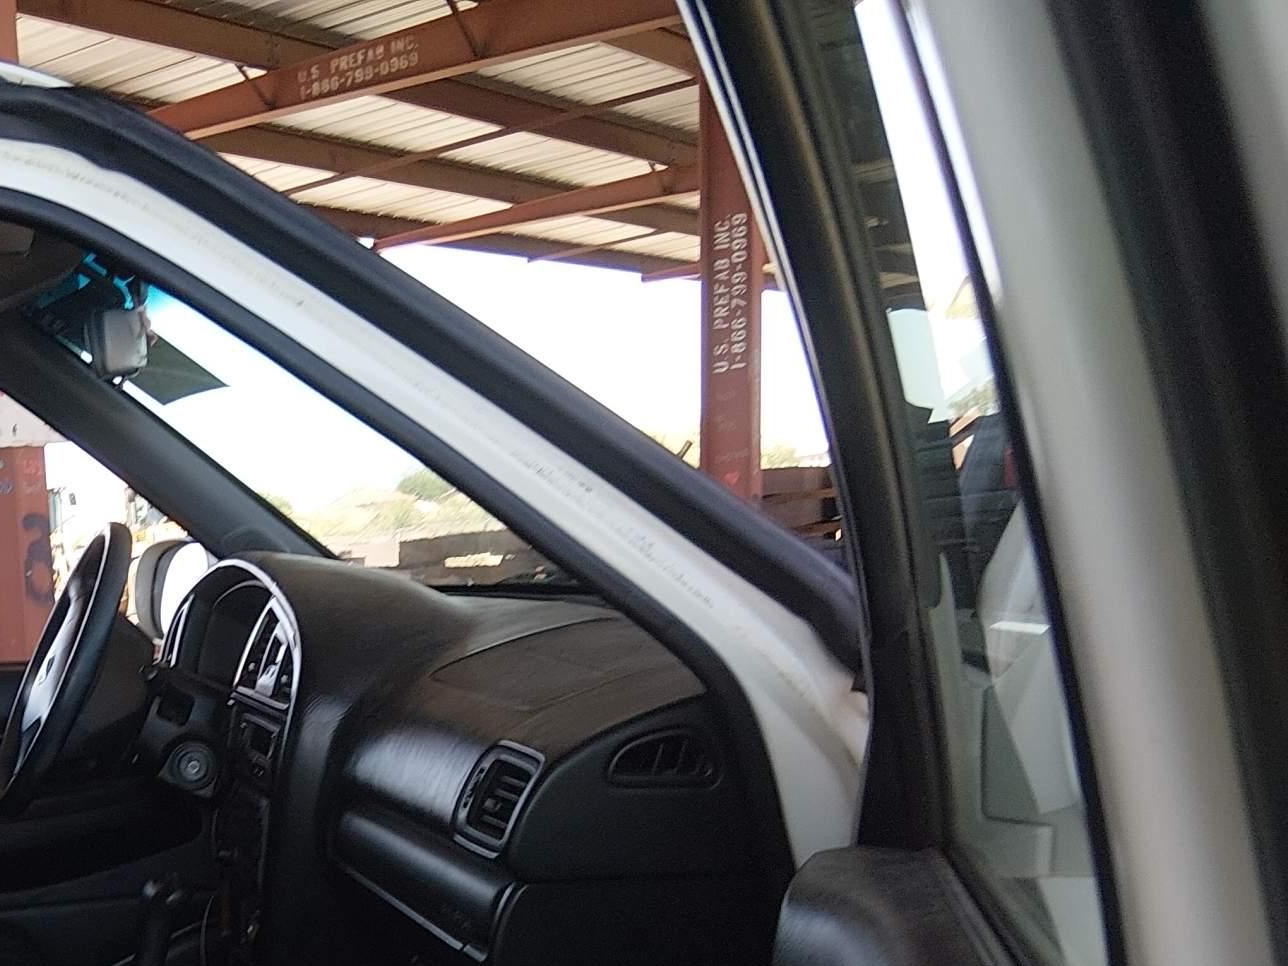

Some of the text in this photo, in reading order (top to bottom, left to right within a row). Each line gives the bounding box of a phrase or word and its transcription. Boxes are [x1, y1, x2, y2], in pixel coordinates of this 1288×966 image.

[330, 45, 385, 74] PREFAB
[391, 35, 419, 55] INC.
[714, 213, 731, 250] INC.
[713, 258, 730, 330] PREFAB
[730, 212, 748, 370] 1-866-799-0969
